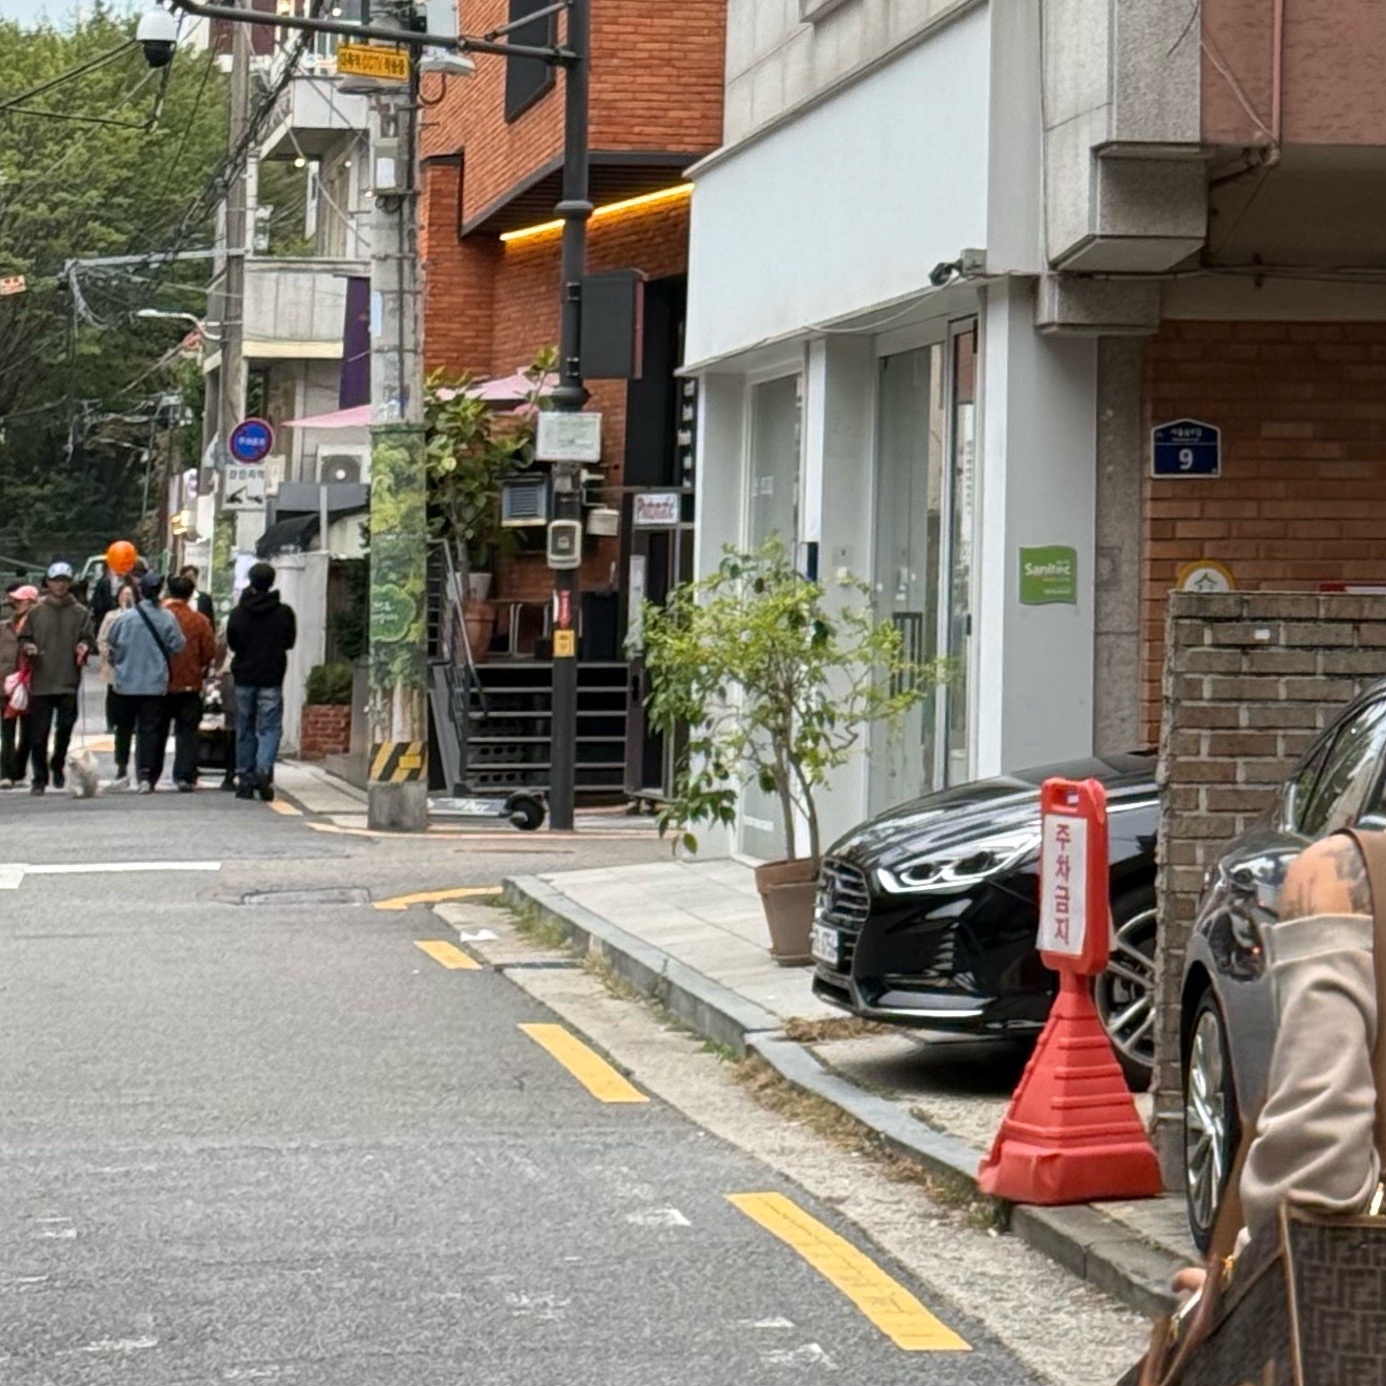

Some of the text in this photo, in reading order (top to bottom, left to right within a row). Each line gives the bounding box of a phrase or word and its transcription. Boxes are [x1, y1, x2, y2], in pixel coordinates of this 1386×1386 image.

[1178, 448, 1193, 470] 9
[1024, 562, 1071, 576] Sanitec
[1054, 823, 1072, 946] 주차금지
